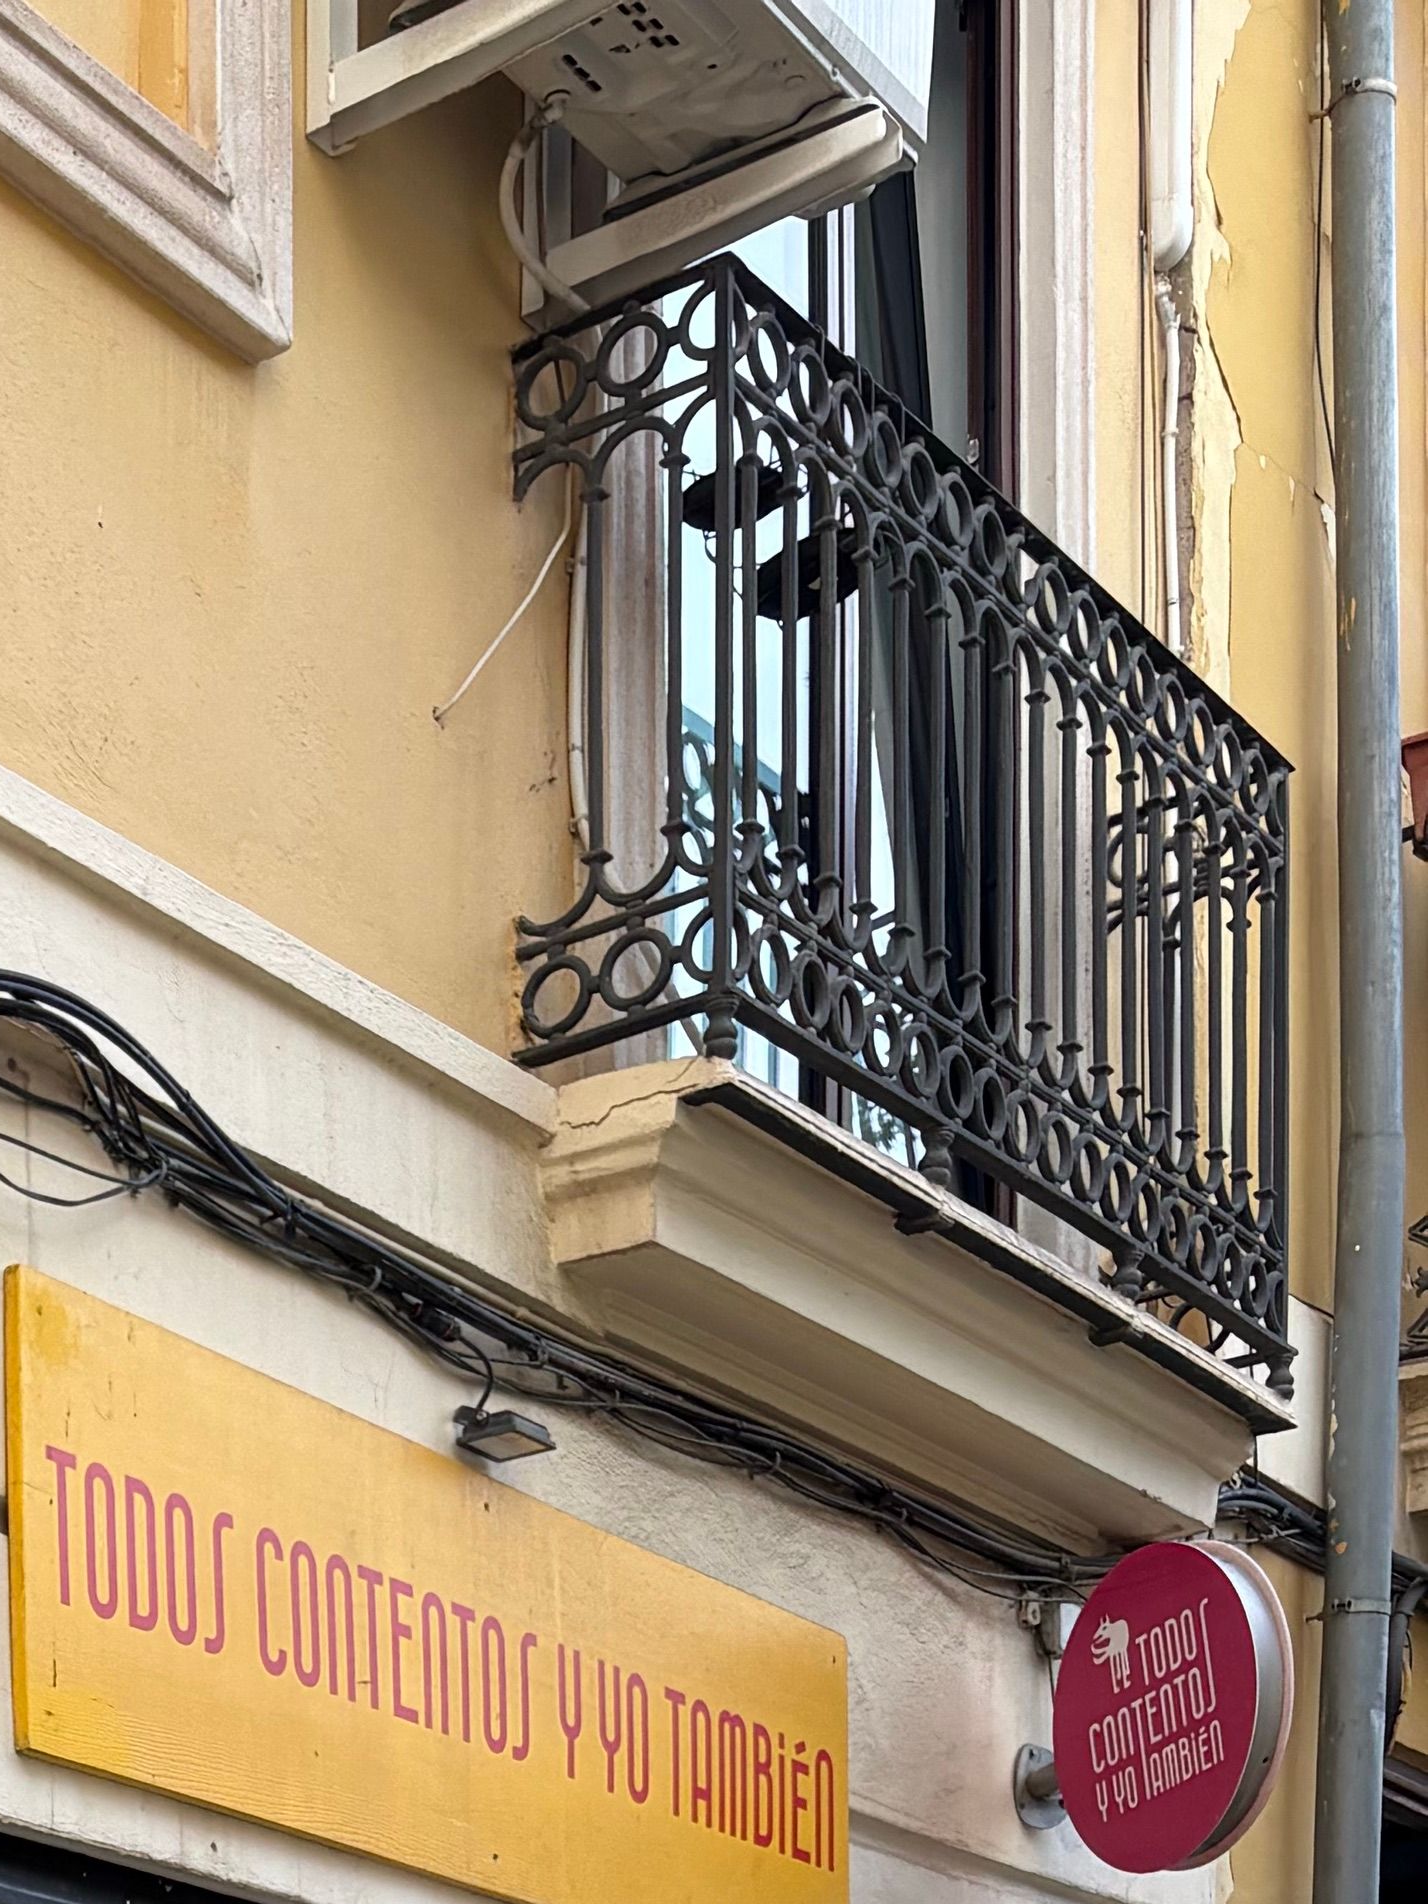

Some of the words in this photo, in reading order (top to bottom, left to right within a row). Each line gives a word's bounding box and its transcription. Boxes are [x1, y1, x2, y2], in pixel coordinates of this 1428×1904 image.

[45, 1444, 234, 1654] TODOS
[255, 1526, 538, 1764] CONTENTOS
[557, 1643, 584, 1780] Y
[597, 1660, 651, 1806] YO
[1135, 1597, 1210, 1690] TODOS
[1088, 1666, 1218, 1776] CONTENTOS
[1095, 1781, 1109, 1823] Y
[1113, 1766, 1139, 1816] YO
